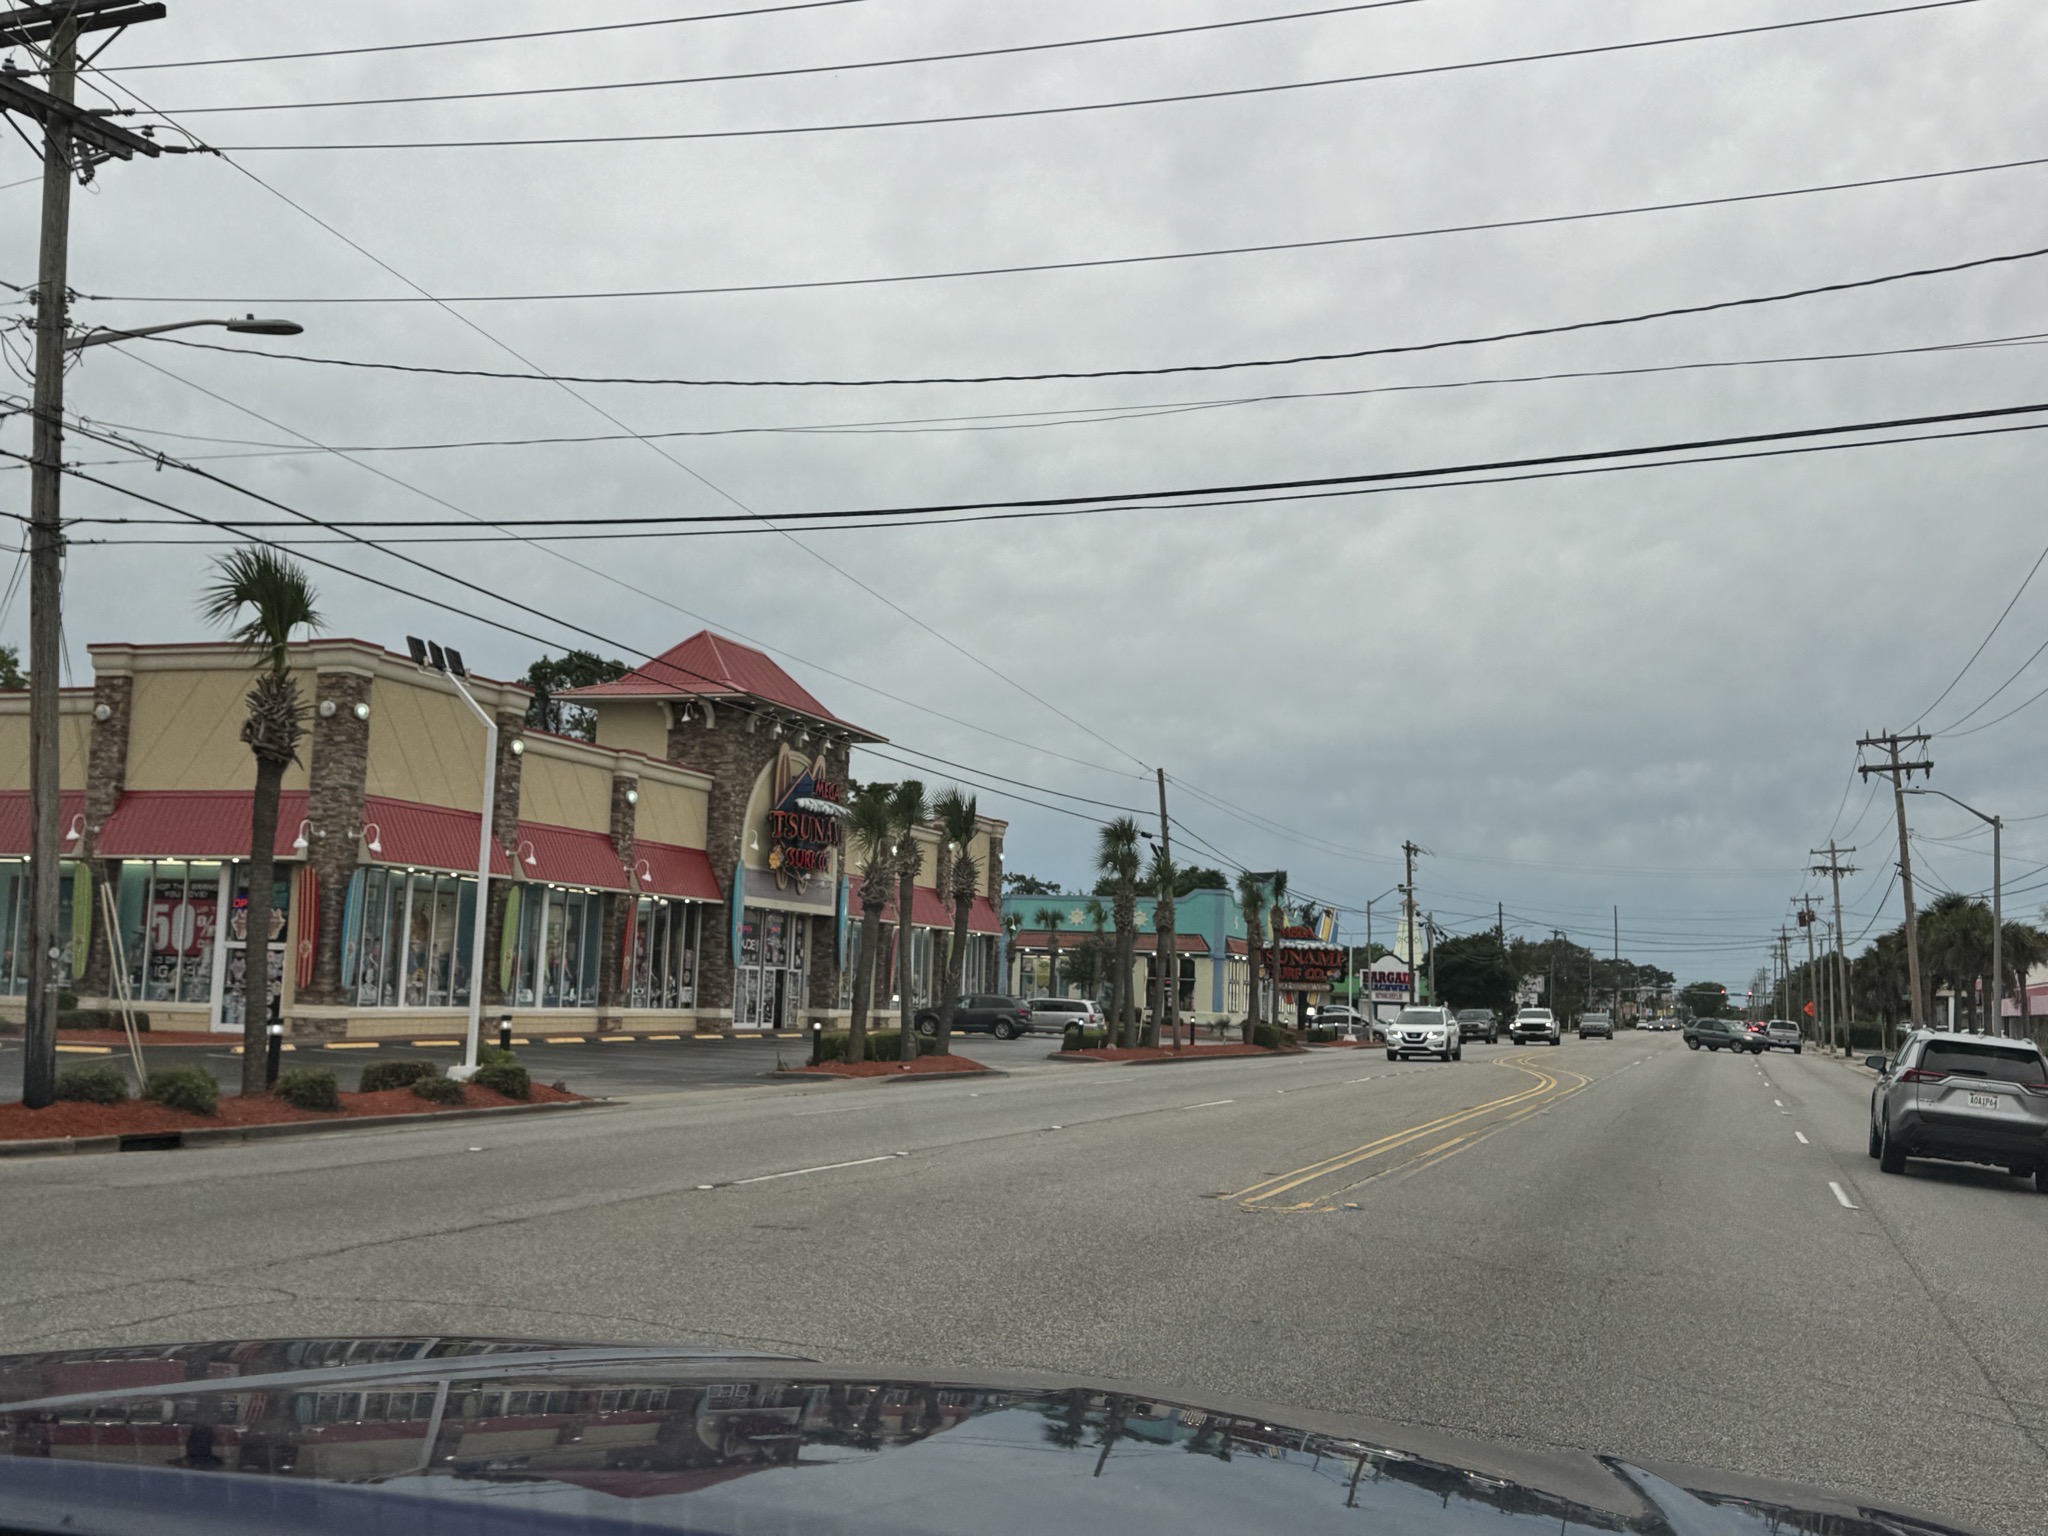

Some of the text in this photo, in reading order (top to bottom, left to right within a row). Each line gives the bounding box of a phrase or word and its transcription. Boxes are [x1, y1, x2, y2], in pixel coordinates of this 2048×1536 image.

[815, 780, 840, 801] MEGA
[232, 899, 248, 908] OP
[1280, 967, 1301, 980] URF
